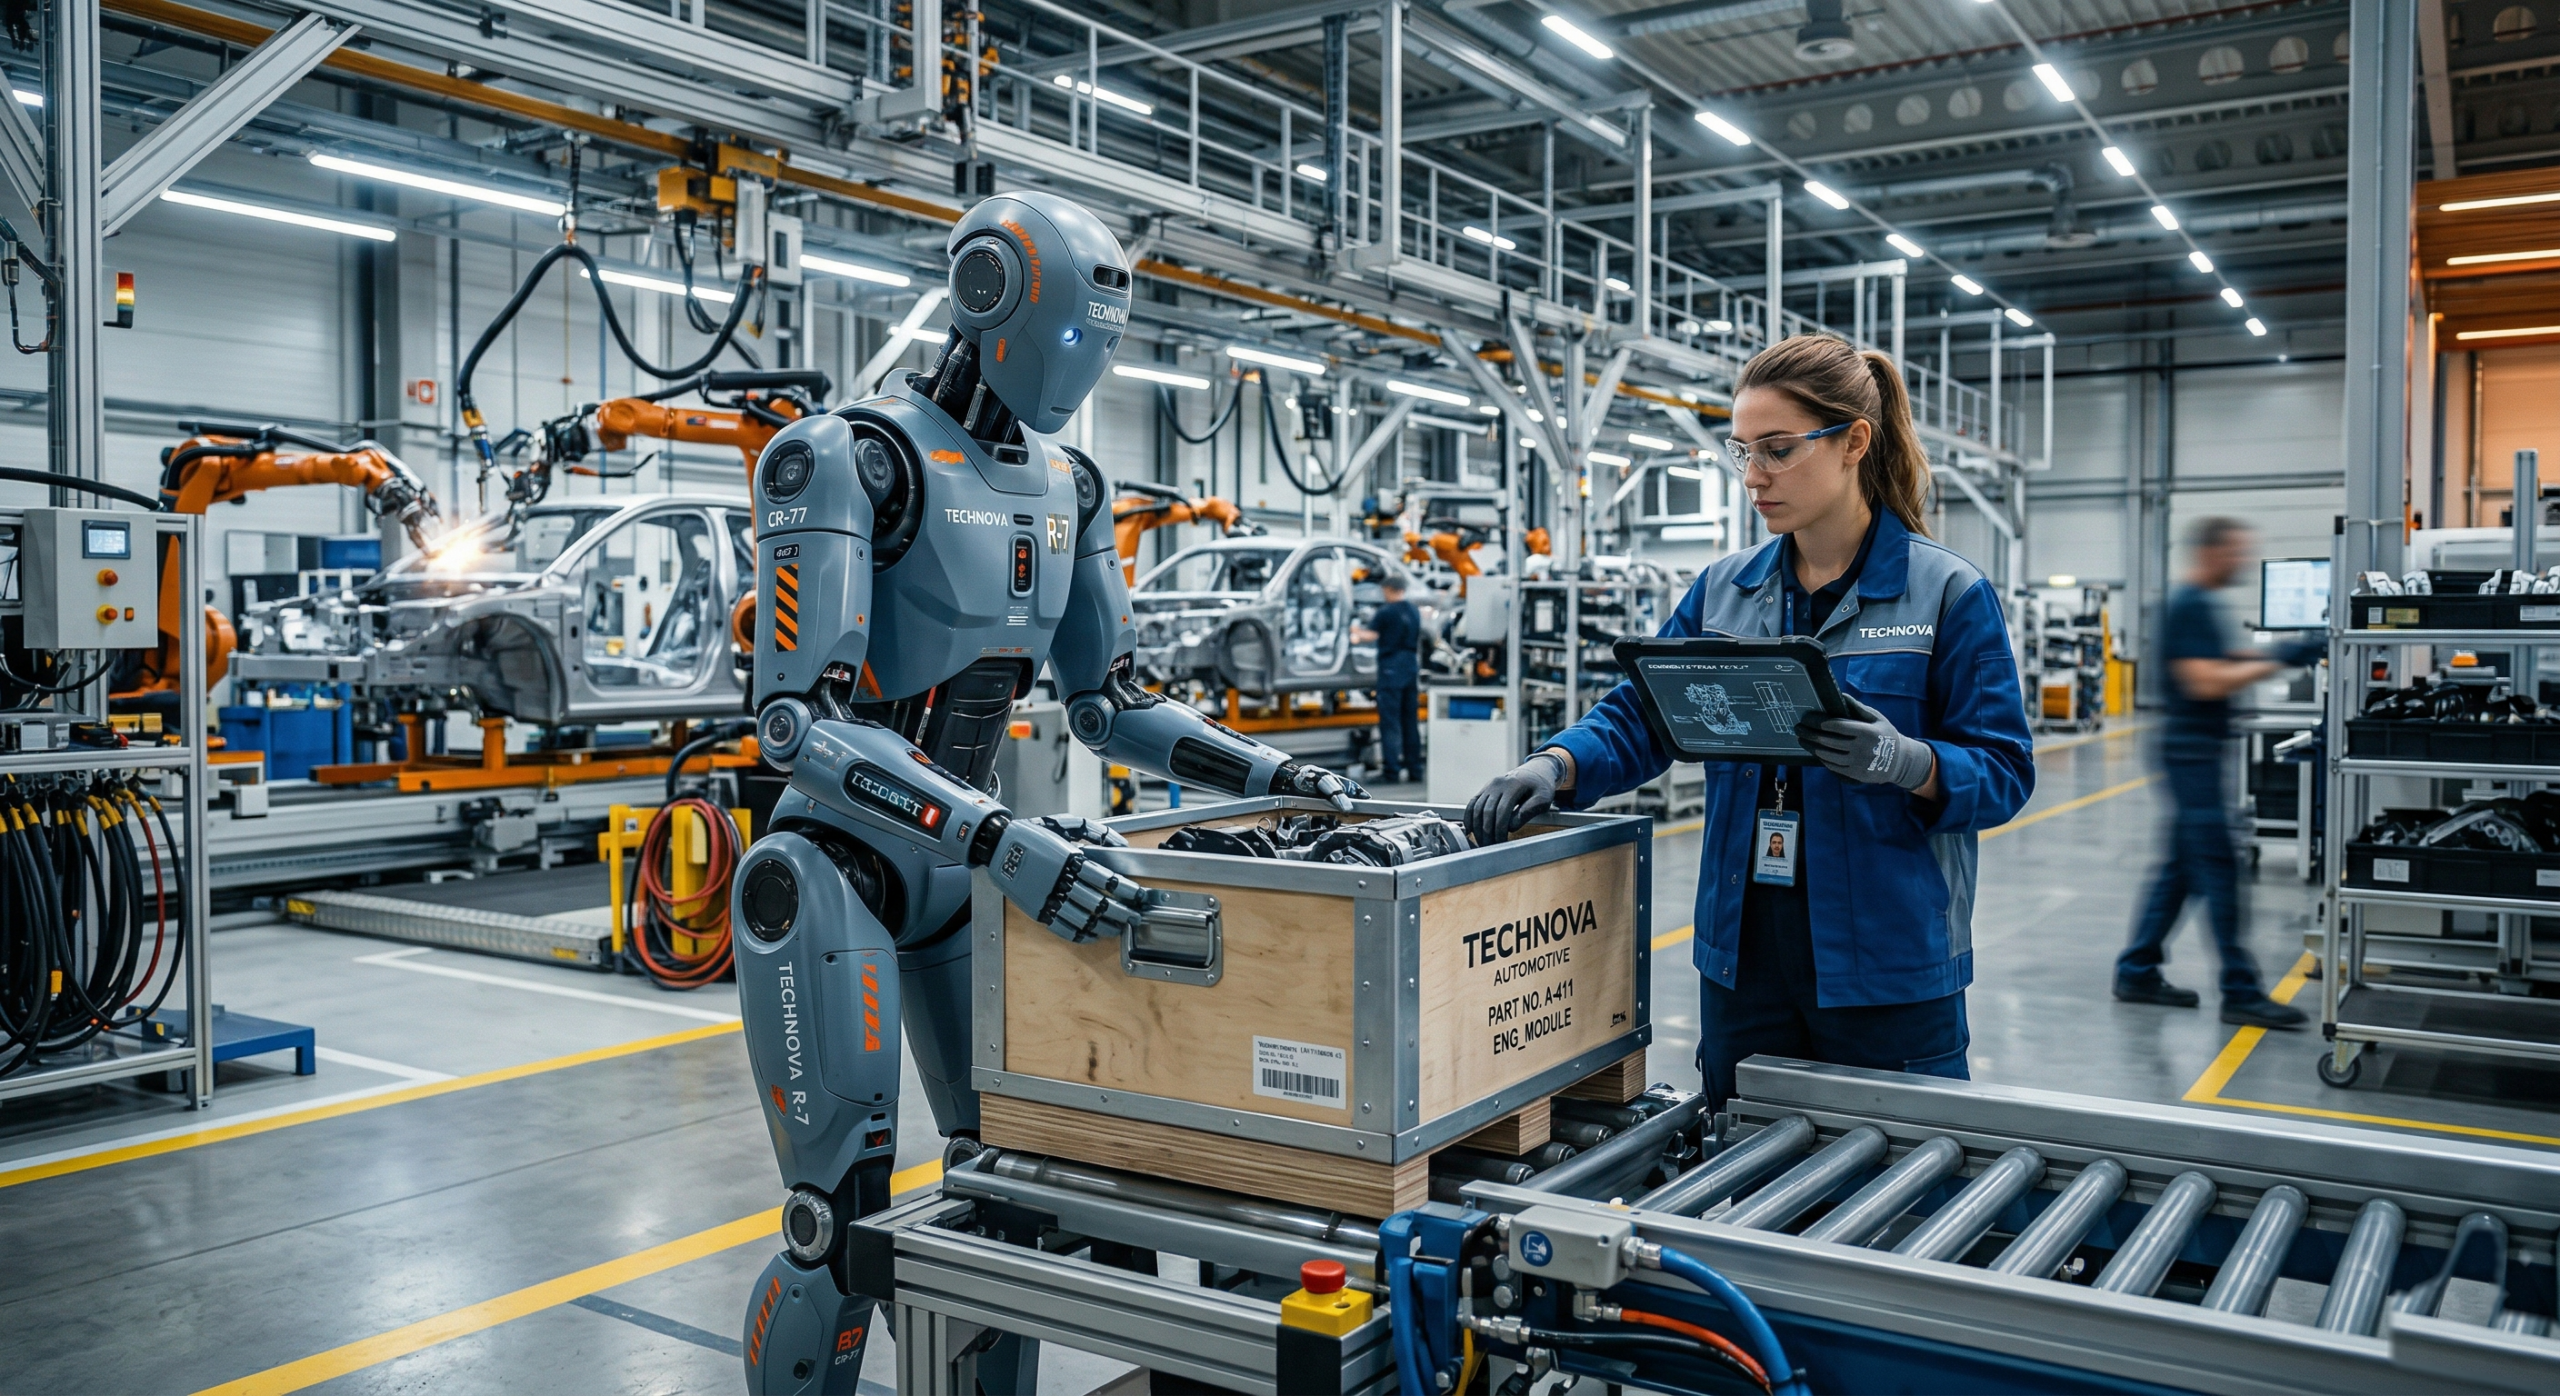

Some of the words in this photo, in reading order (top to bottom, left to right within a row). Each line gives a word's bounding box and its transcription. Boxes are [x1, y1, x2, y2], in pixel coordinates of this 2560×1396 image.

[768, 506, 808, 528] CR-77
[944, 508, 1009, 527] TECHNOVA
[1045, 514, 1069, 550] R-7
[1859, 624, 1934, 638] TECHNOVA
[1462, 899, 1598, 969] TECHNOVA
[1493, 947, 1571, 986] AUTOMOTIVE
[1488, 997, 1520, 1027] PART
[1522, 990, 1542, 1015] NO.
[1544, 978, 1574, 1007] A-411
[778, 961, 804, 1081] TECHNOVA
[792, 1091, 810, 1126] R-7
[1493, 1007, 1572, 1055] ENG_MODULE
